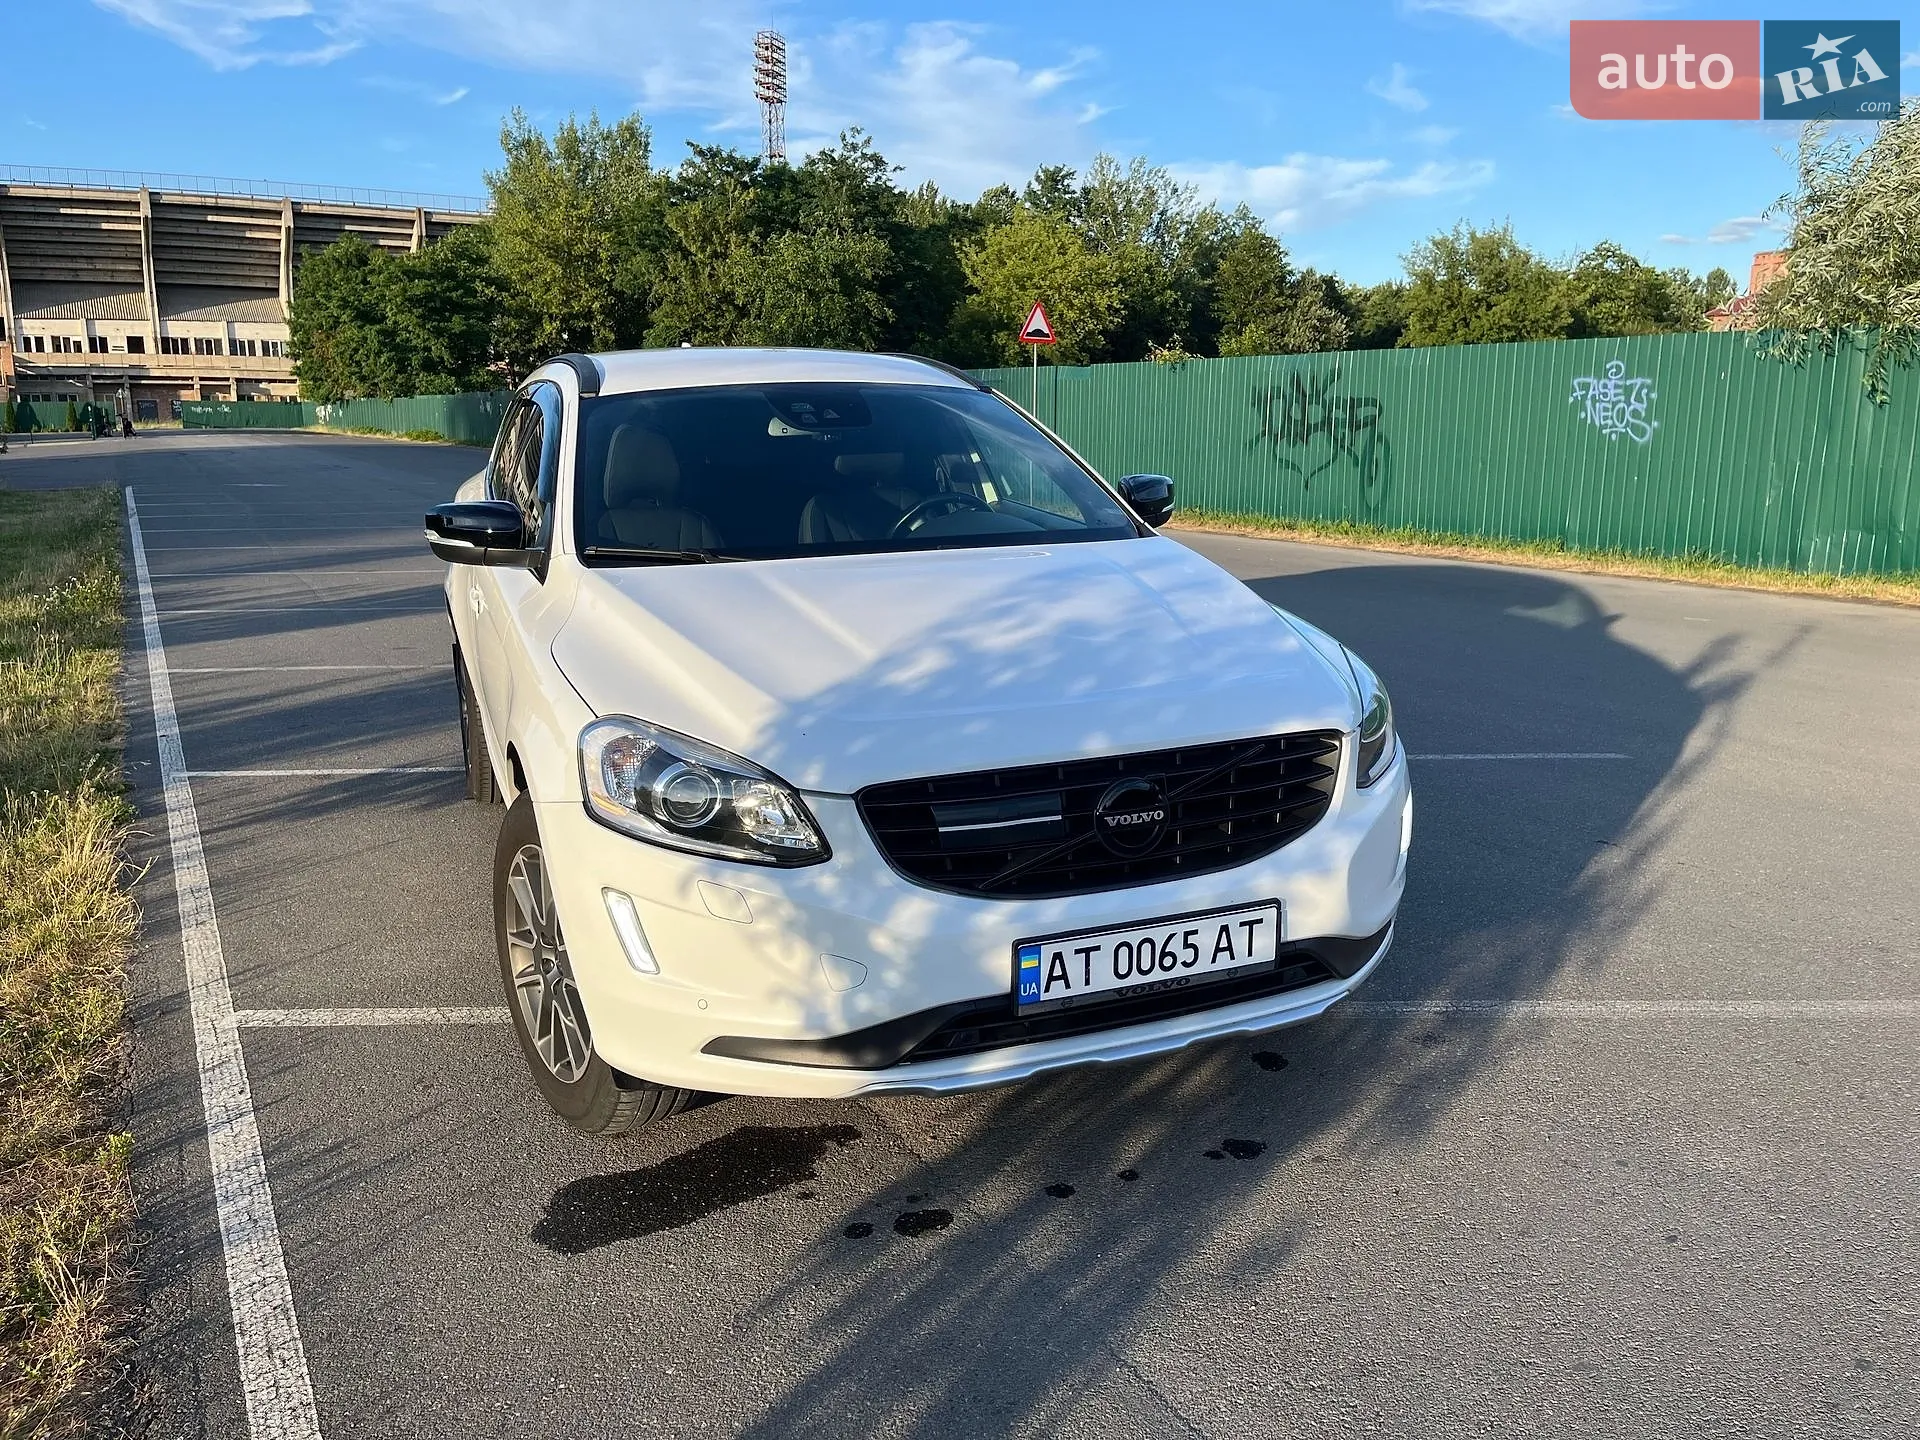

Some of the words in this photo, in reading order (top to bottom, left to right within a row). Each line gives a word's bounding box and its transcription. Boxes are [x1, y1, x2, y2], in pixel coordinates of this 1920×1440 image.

[1104, 809, 1165, 828] VOLVO
[1043, 944, 1102, 994] AT
[1112, 929, 1200, 980] 0065
[1210, 917, 1264, 965] AT
[1020, 982, 1039, 997] UA
[1113, 977, 1191, 998] VOLVO
